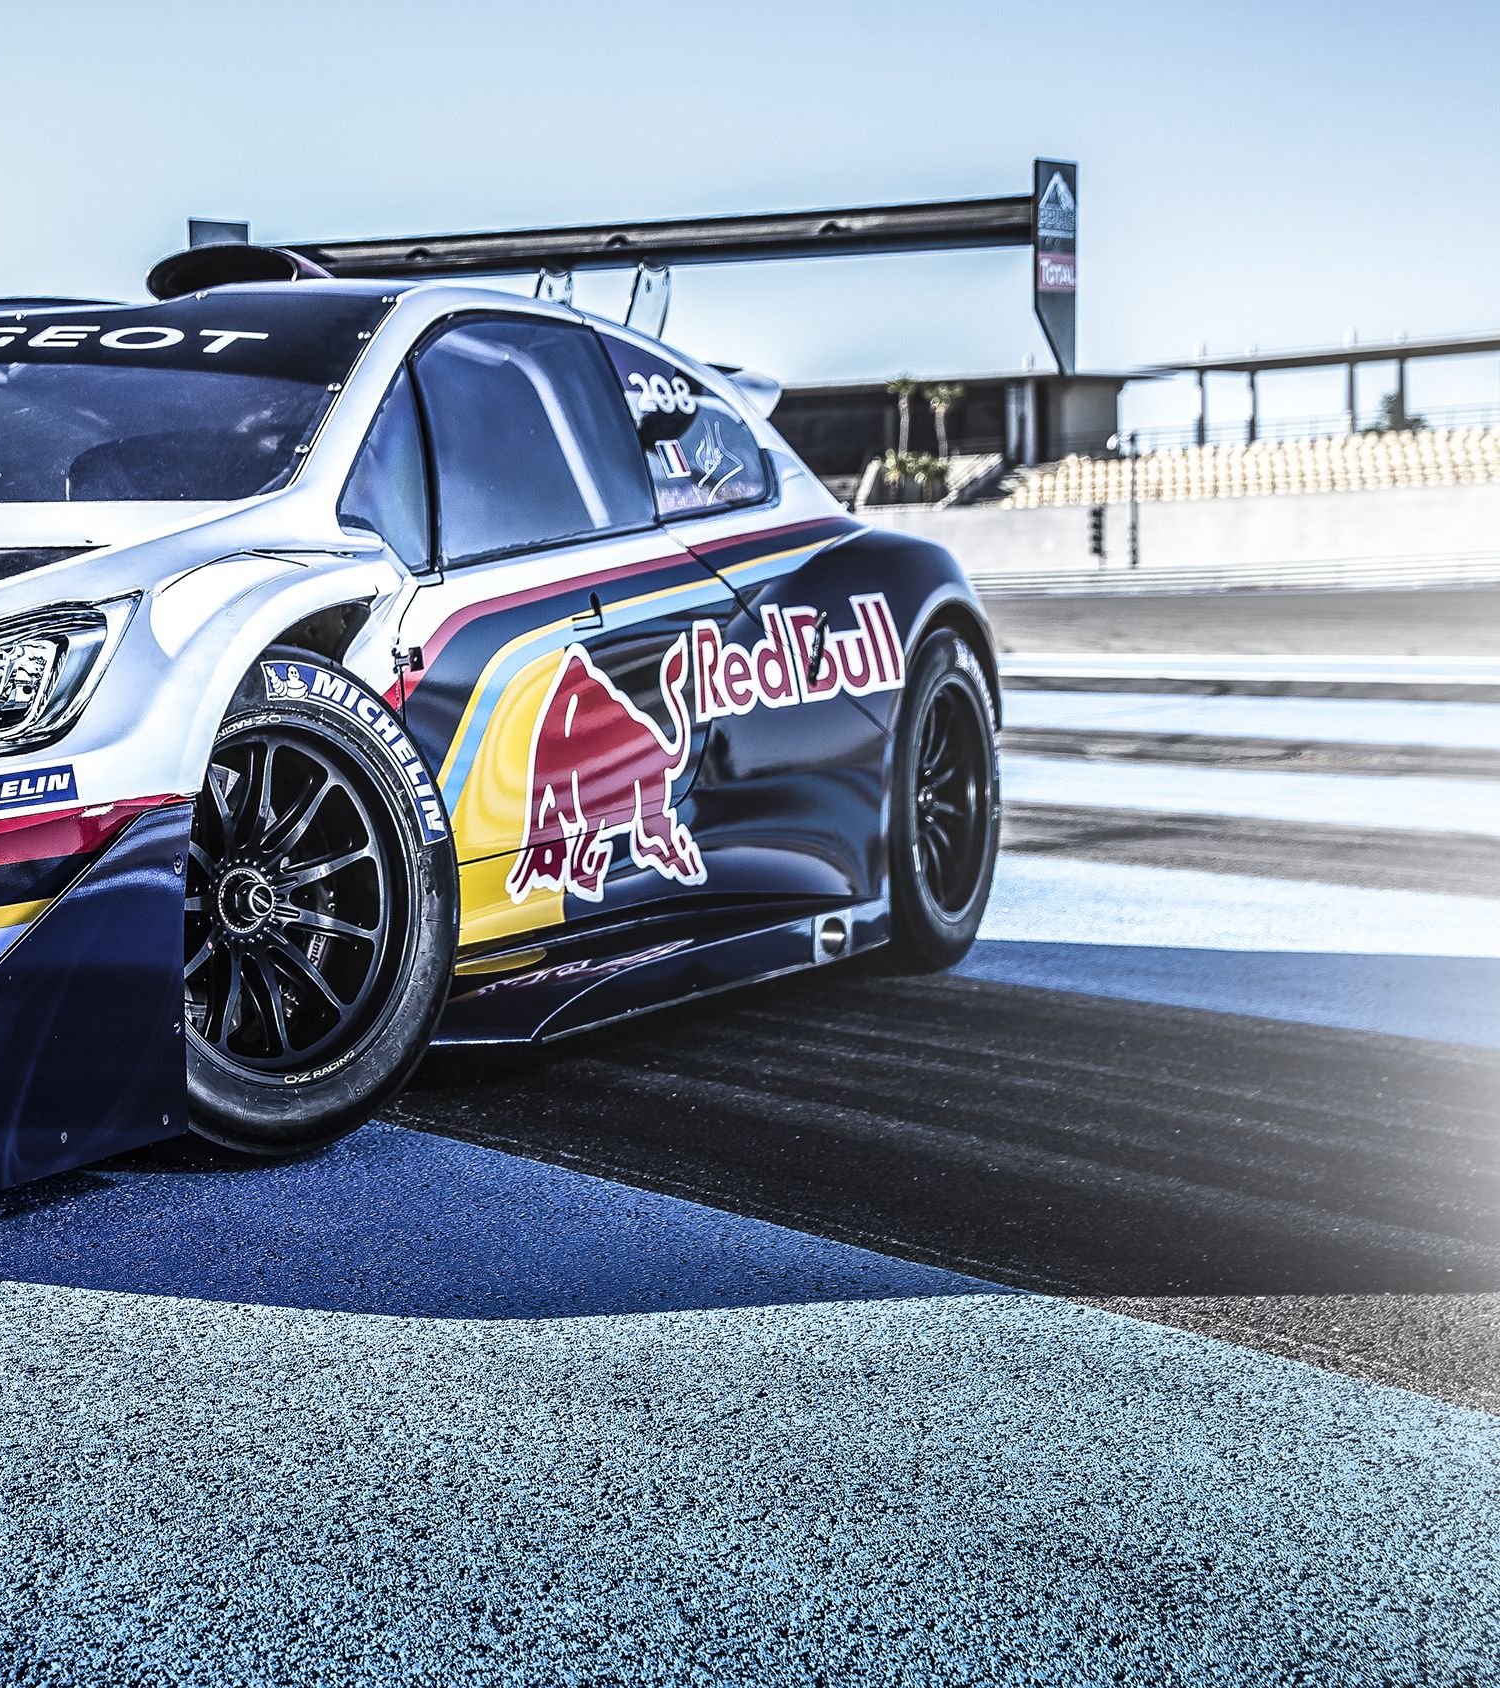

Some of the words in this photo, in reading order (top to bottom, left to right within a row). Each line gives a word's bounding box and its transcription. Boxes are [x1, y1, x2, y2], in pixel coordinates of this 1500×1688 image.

[627, 371, 697, 415] 208
[694, 606, 796, 718] Red
[787, 597, 902, 699] Bull
[310, 670, 446, 832] MICHELIN
[313, 1050, 355, 1078] RACING
